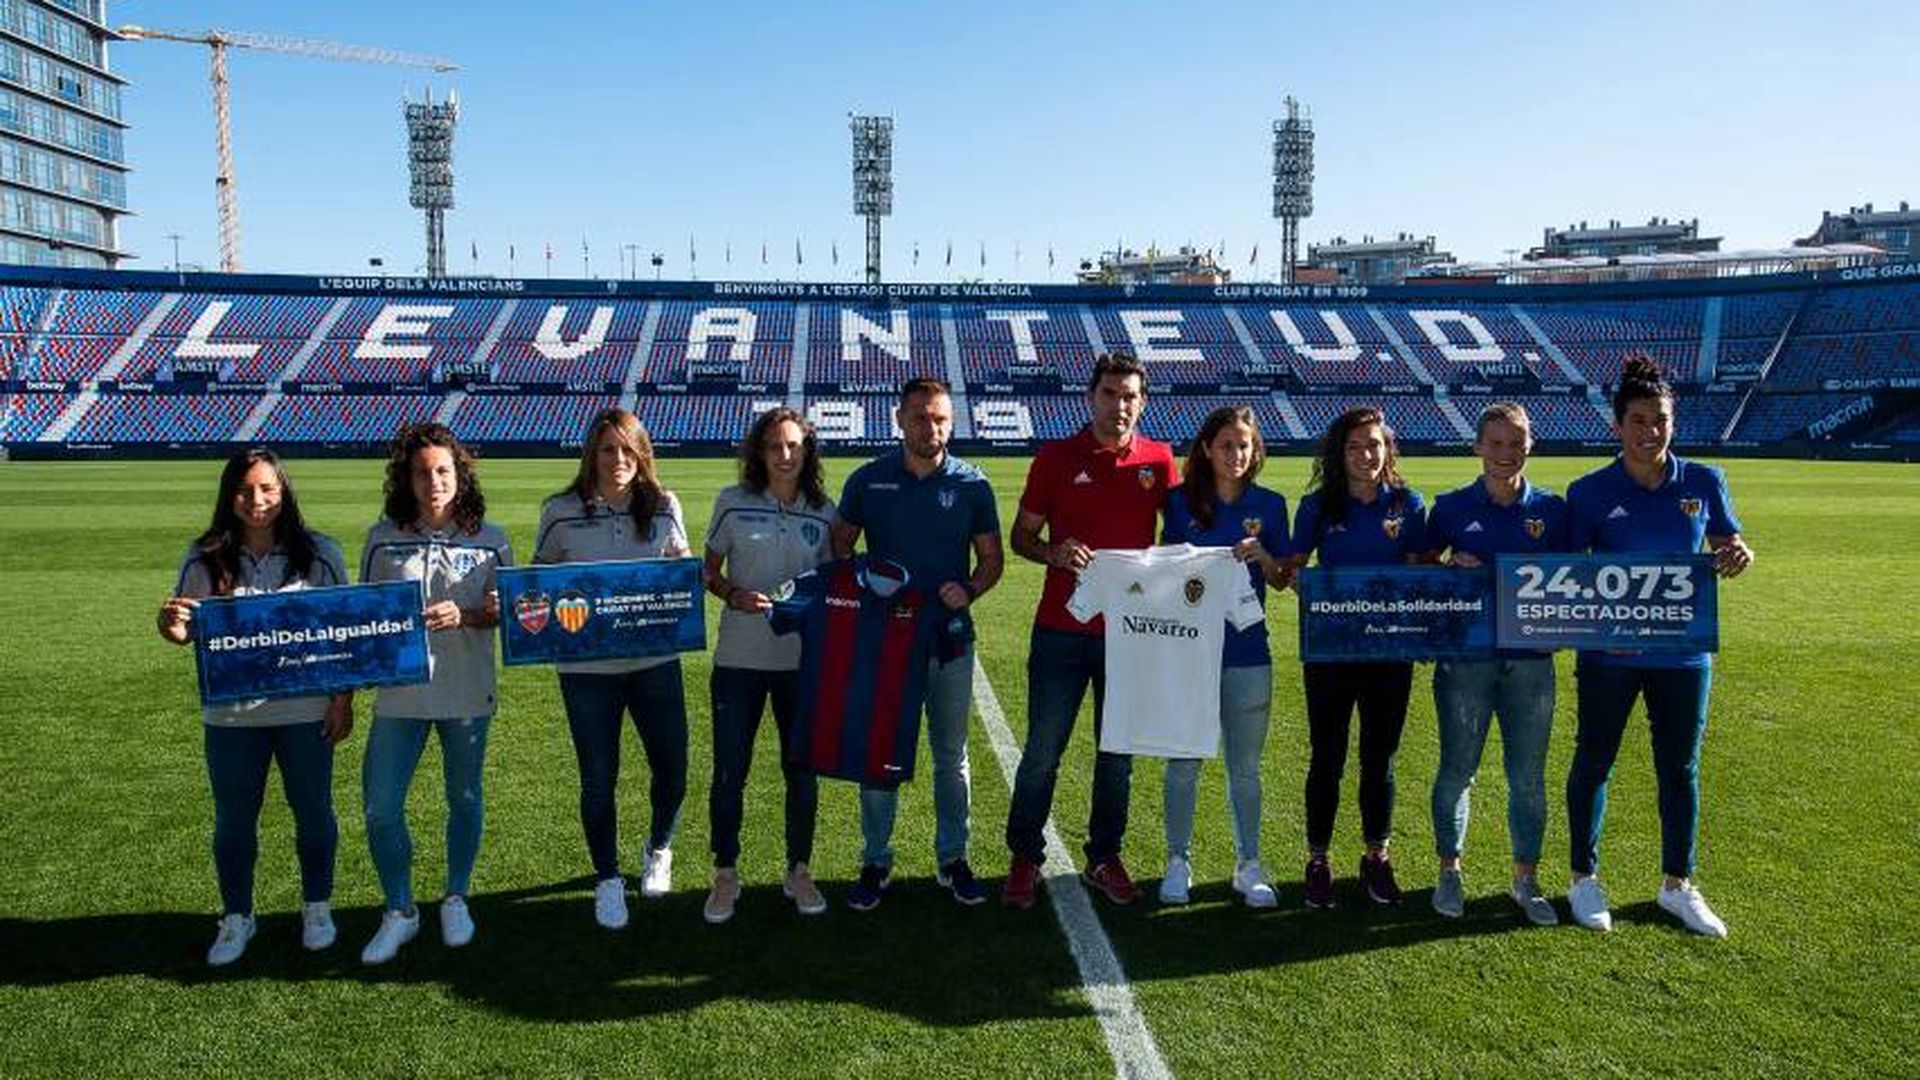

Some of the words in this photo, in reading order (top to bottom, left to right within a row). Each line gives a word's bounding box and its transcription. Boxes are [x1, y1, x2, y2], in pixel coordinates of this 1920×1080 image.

[1841, 266, 1878, 280] QUE
[319, 277, 380, 290] L'EQUIP
[384, 278, 425, 290] DELS
[428, 279, 524, 291] VALENCIANS
[714, 282, 805, 295] BENVINGUTS
[808, 284, 819, 295] A
[887, 285, 936, 296] CIUTAT
[940, 285, 959, 296] DE
[962, 285, 1032, 297] VALENCIA
[1213, 286, 1251, 297] CLUB
[1253, 286, 1309, 297] FUNDAT
[1313, 286, 1333, 297] EN
[1336, 286, 1369, 297] 1909
[172, 300, 1206, 362] LEVANTE
[26, 381, 66, 393] betway
[1807, 395, 1875, 439] macron
[1515, 564, 1694, 600] 24.073
[1310, 597, 1482, 614] #DerbiDeLaSolidaridad
[1516, 603, 1694, 621] ESPECTADORES
[208, 617, 414, 652] #DerbiDeLaIgualdad
[1122, 615, 1199, 639] Navarro
